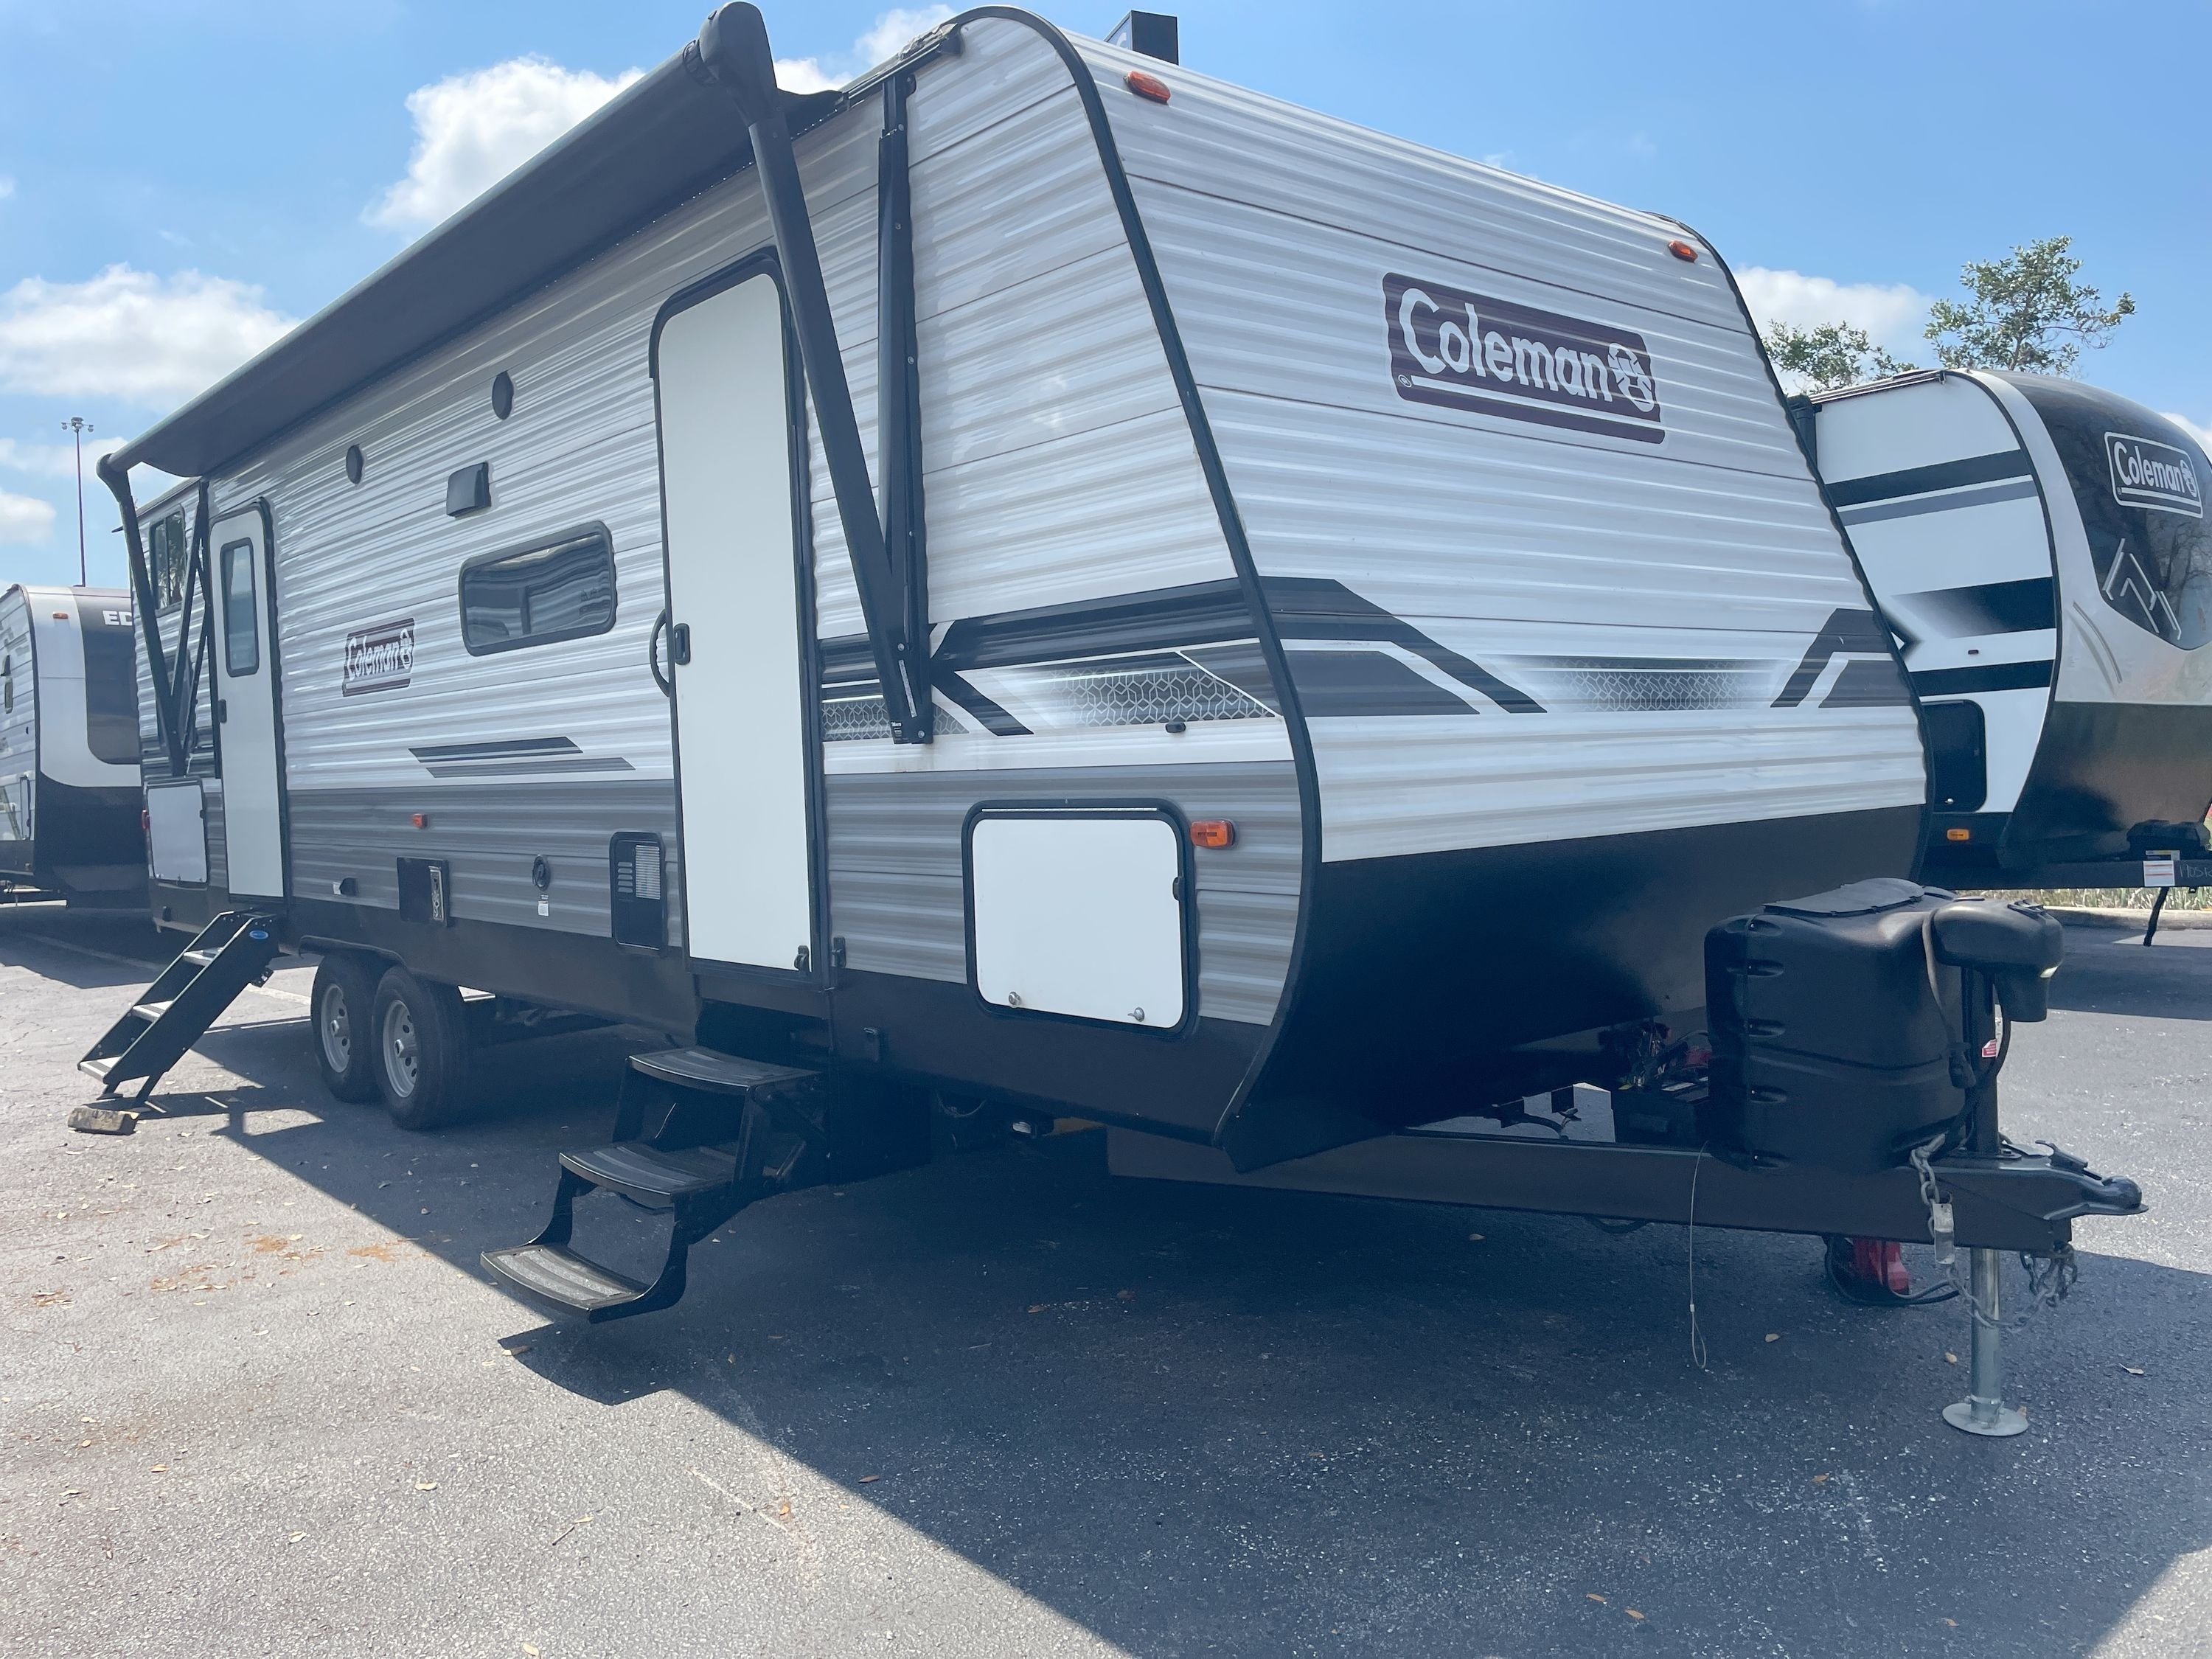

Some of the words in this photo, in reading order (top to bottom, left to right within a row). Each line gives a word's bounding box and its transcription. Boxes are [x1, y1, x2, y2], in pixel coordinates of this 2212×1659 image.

[1399, 288, 1613, 402] Coleman
[2114, 441, 2185, 493] Coleman
[347, 636, 399, 681] Coleman
